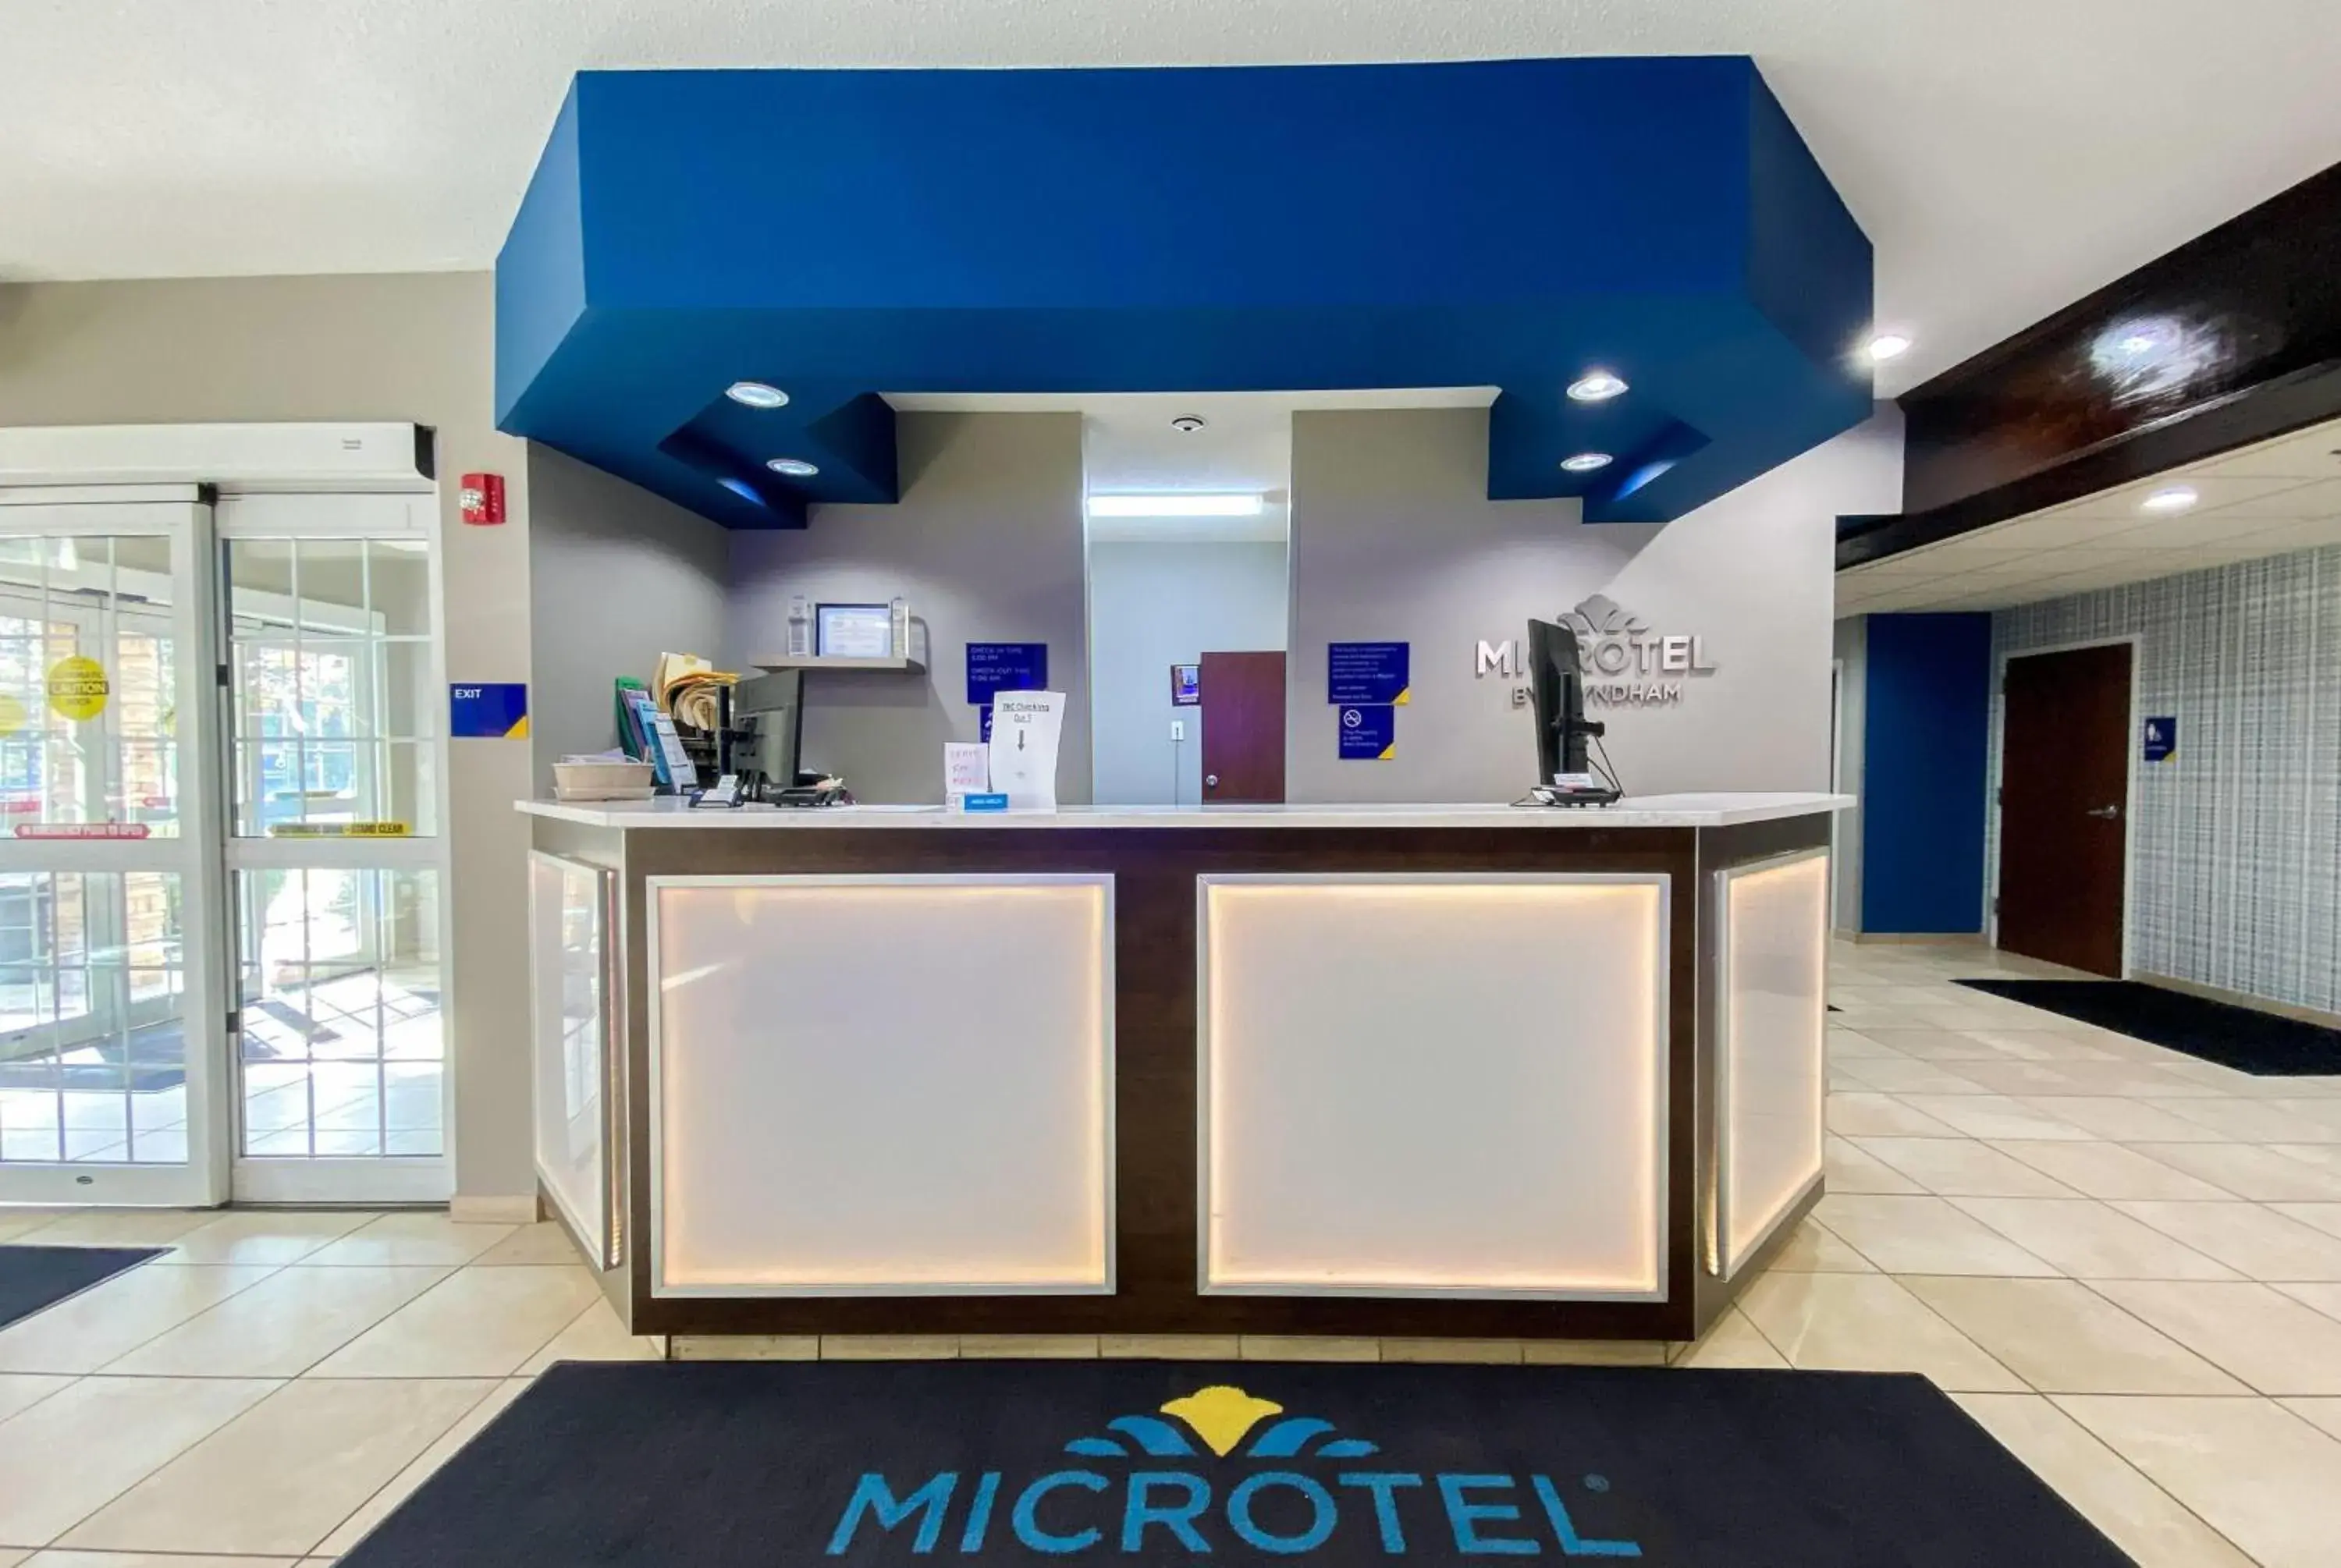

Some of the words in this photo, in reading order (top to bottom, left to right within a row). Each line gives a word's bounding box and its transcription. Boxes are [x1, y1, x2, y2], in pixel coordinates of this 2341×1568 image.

[1476, 636, 1714, 674] MIROTEL
[51, 682, 107, 694] CAUTION
[455, 689, 482, 699] EXIT
[1583, 683, 1680, 702] YNDHAM
[378, 823, 404, 833] CLEAR
[826, 1469, 1643, 1556] MICROTEL
